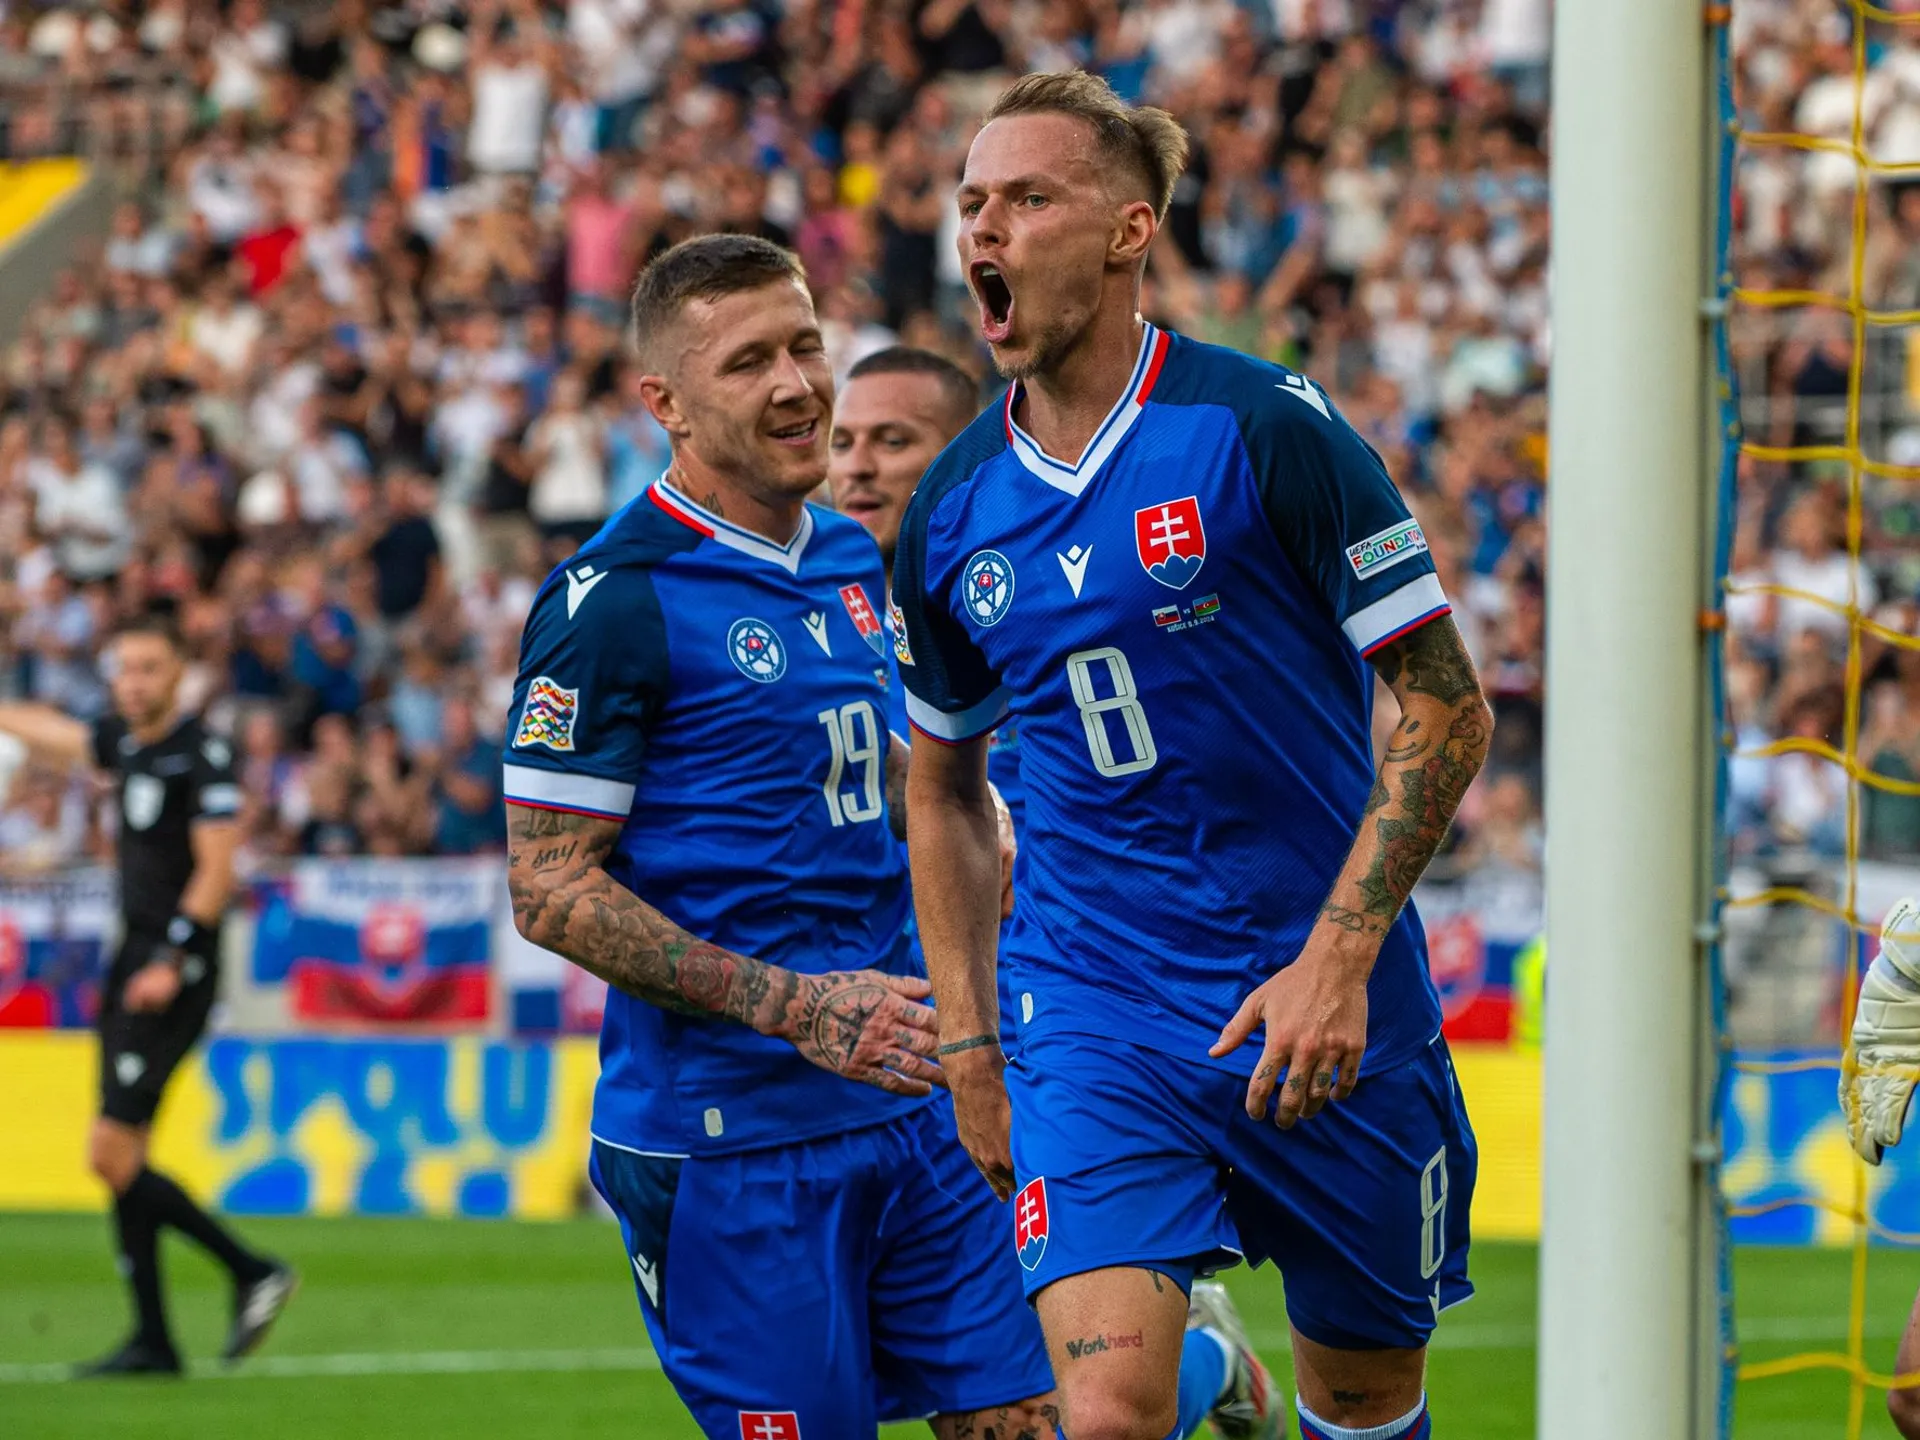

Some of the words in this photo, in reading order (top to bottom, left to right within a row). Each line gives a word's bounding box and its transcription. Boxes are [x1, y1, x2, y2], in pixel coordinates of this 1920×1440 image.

[1349, 541, 1373, 557] UEFA
[818, 700, 882, 827] 19
[1066, 647, 1157, 777] 8
[1420, 1145, 1448, 1279] 8
